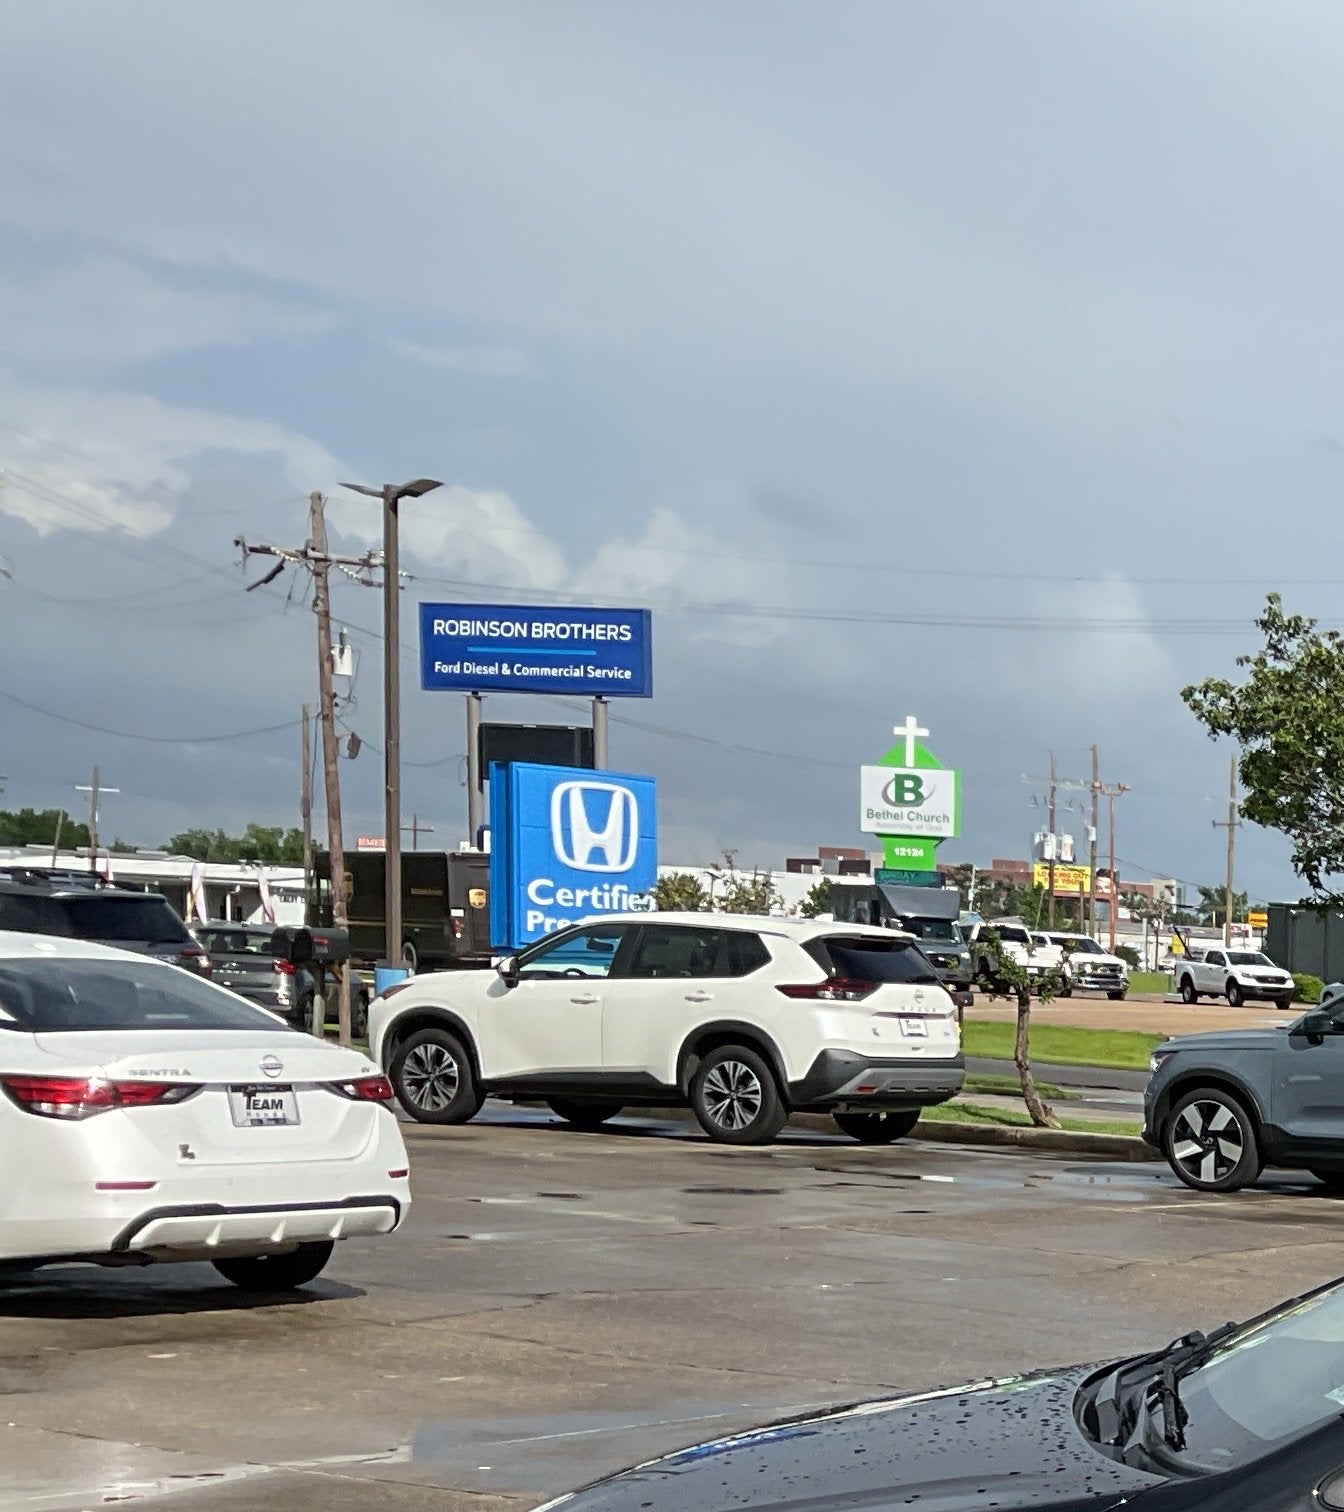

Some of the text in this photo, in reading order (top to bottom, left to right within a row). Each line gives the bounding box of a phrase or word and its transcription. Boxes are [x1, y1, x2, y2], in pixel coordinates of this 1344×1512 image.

[433, 619, 632, 641] ROBINSON BROTHERS
[434, 661, 632, 679] Ford Diesel & Commercial Service
[866, 808, 950, 824] Bethel Church
[128, 1068, 192, 1077] SENTRA
[243, 1087, 283, 1110] TEAM
